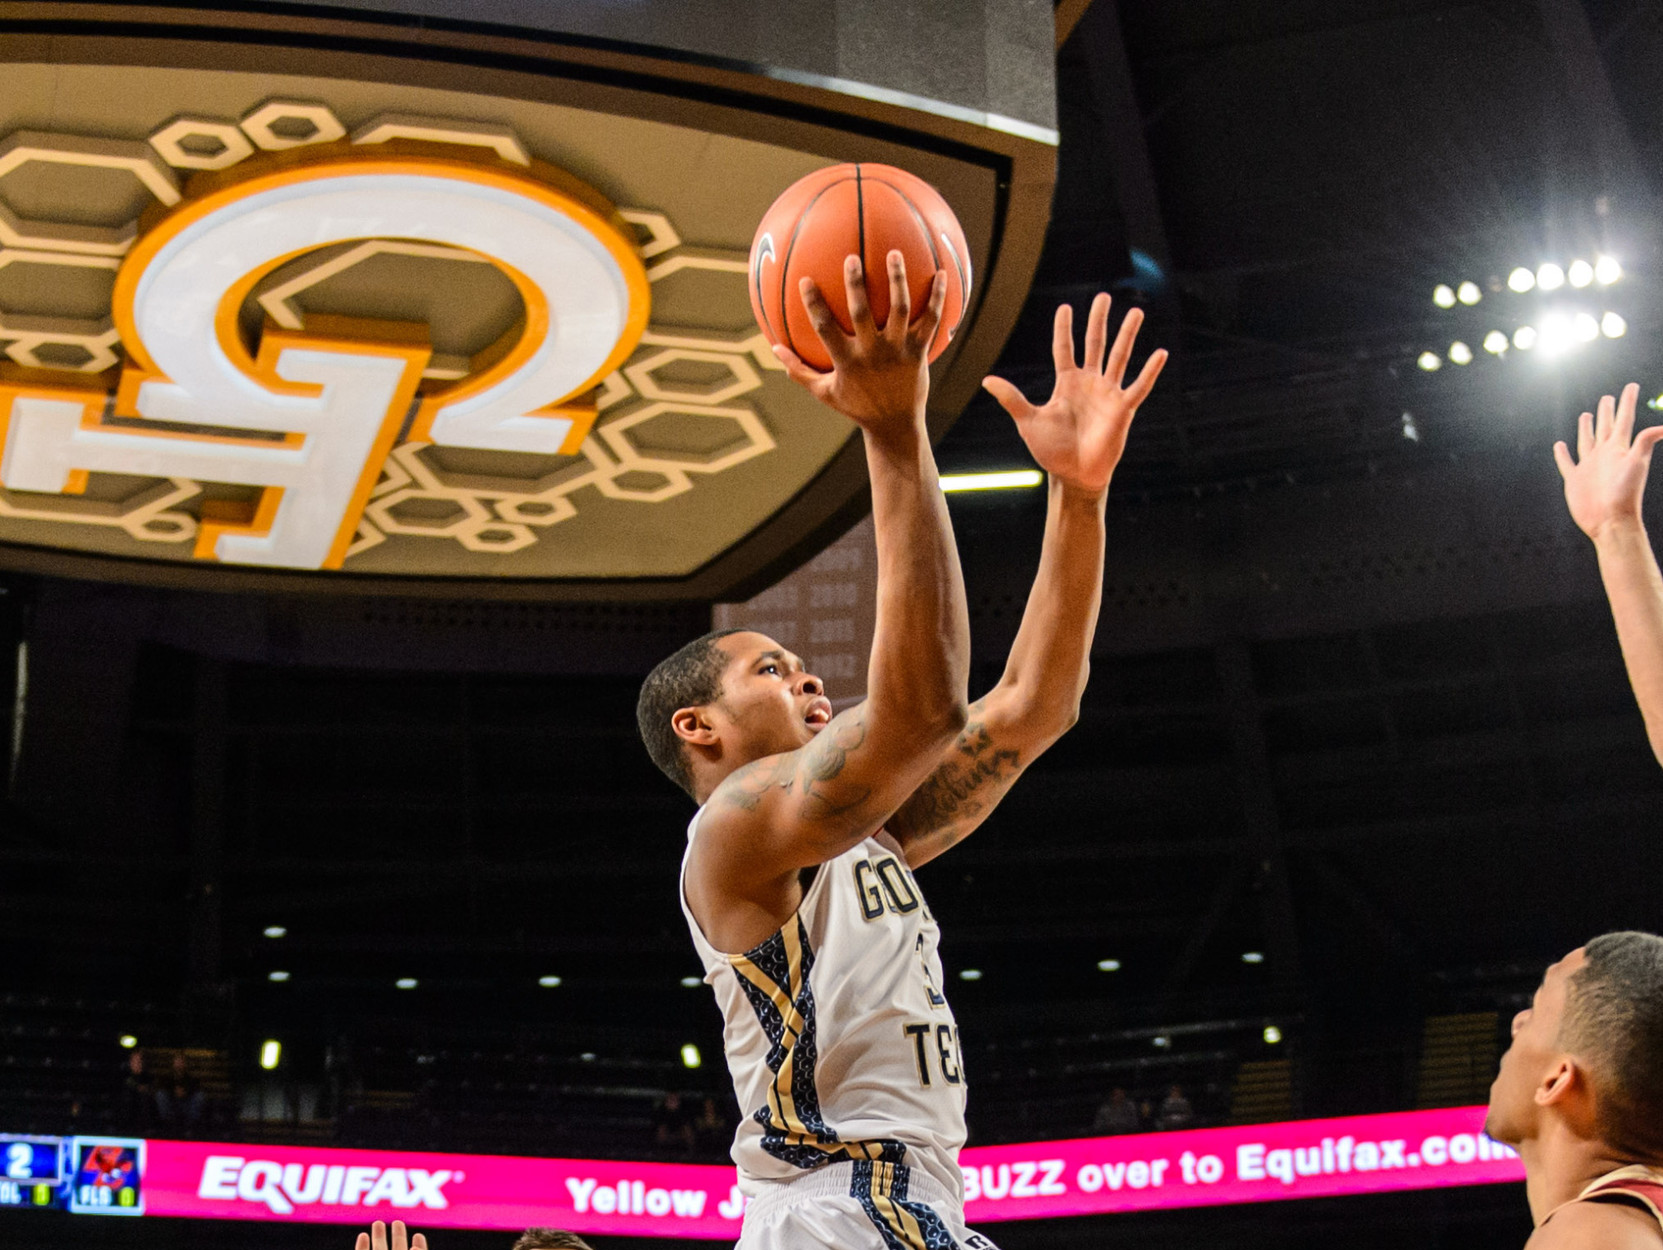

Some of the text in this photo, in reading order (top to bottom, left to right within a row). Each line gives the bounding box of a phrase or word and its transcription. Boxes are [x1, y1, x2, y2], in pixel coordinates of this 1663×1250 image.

[198, 1155, 455, 1214] EQUIFAX
[564, 1176, 708, 1218] Yellow
[962, 1159, 1067, 1202] BUZZ
[1076, 1157, 1169, 1193] over
[1179, 1150, 1224, 1185] to
